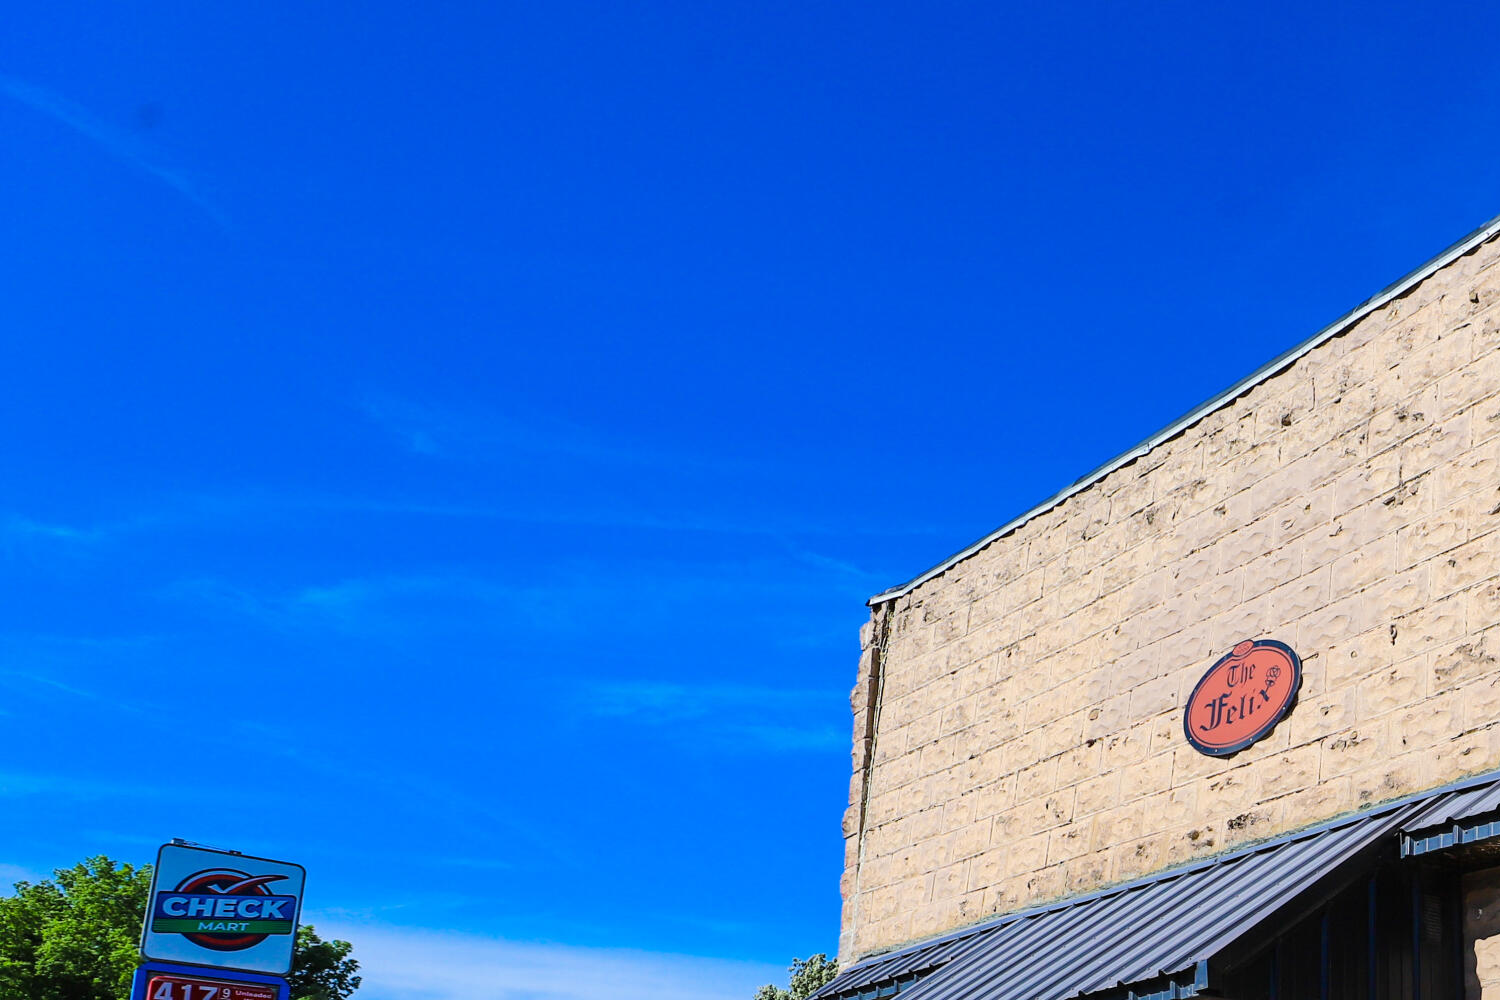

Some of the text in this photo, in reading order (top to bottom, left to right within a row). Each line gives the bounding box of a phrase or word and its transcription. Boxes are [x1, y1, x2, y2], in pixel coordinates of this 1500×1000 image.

[1227, 662, 1256, 688] The
[1200, 688, 1271, 731] Felix
[162, 896, 288, 919] CHECK
[197, 922, 250, 931] MART
[235, 990, 272, 999] Unleaded
